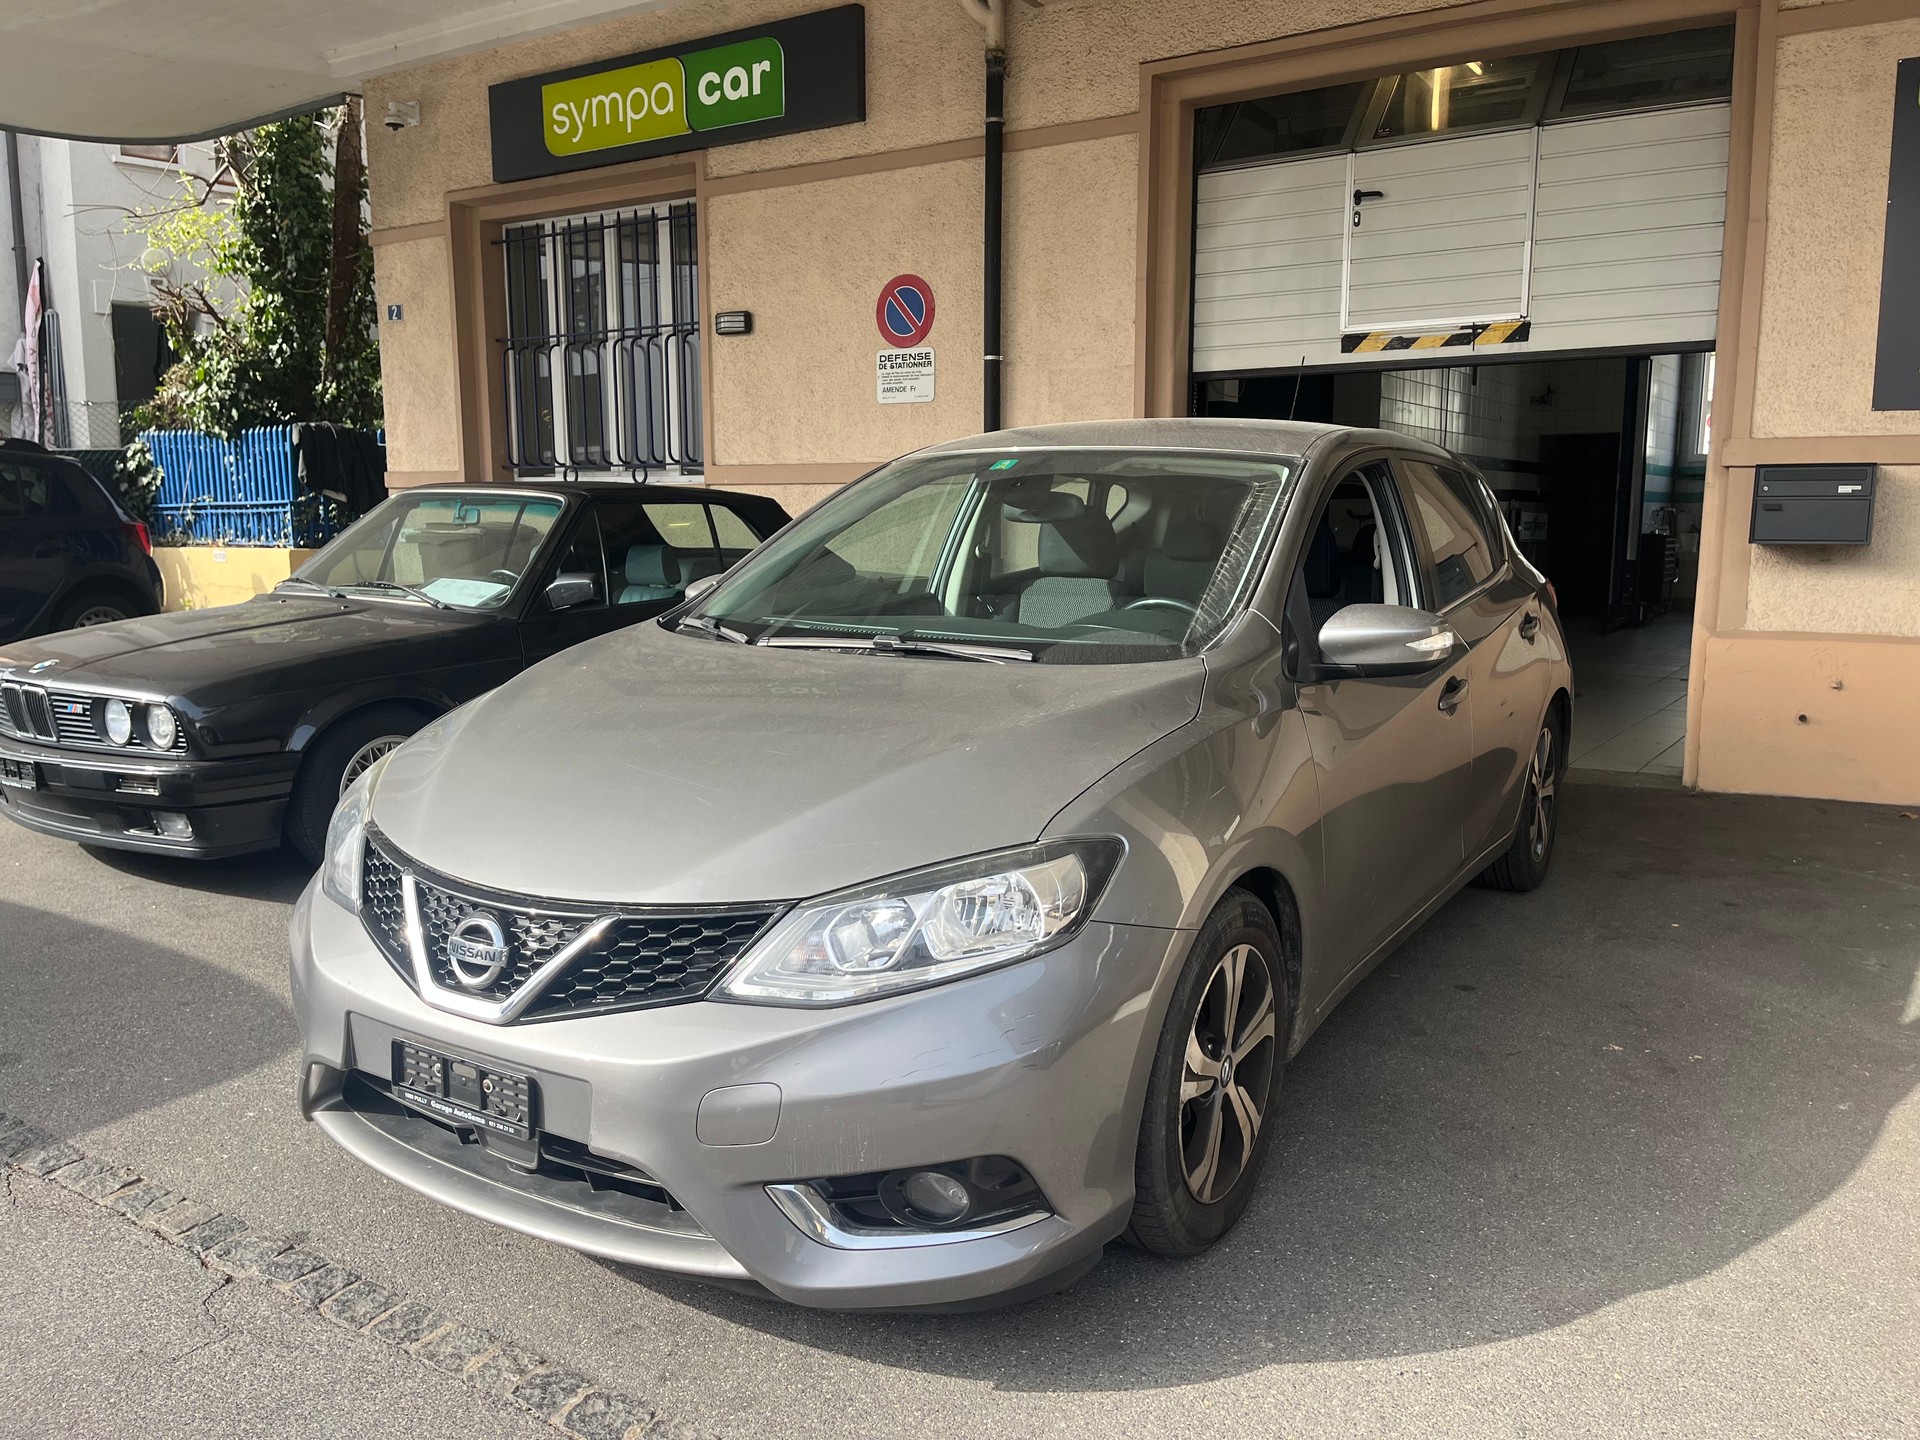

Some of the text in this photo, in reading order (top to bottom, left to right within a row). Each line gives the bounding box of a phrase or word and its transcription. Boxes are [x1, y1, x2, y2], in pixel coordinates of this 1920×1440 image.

[551, 59, 771, 143] sympa car
[391, 305, 398, 320] 2
[880, 352, 931, 362] DEFENSE
[889, 361, 932, 369] STATIONNER
[882, 385, 907, 393] AMENDE
[449, 942, 497, 962] NISSAN
[430, 1100, 453, 1114] Garage
[453, 1108, 486, 1124] AutoSema
